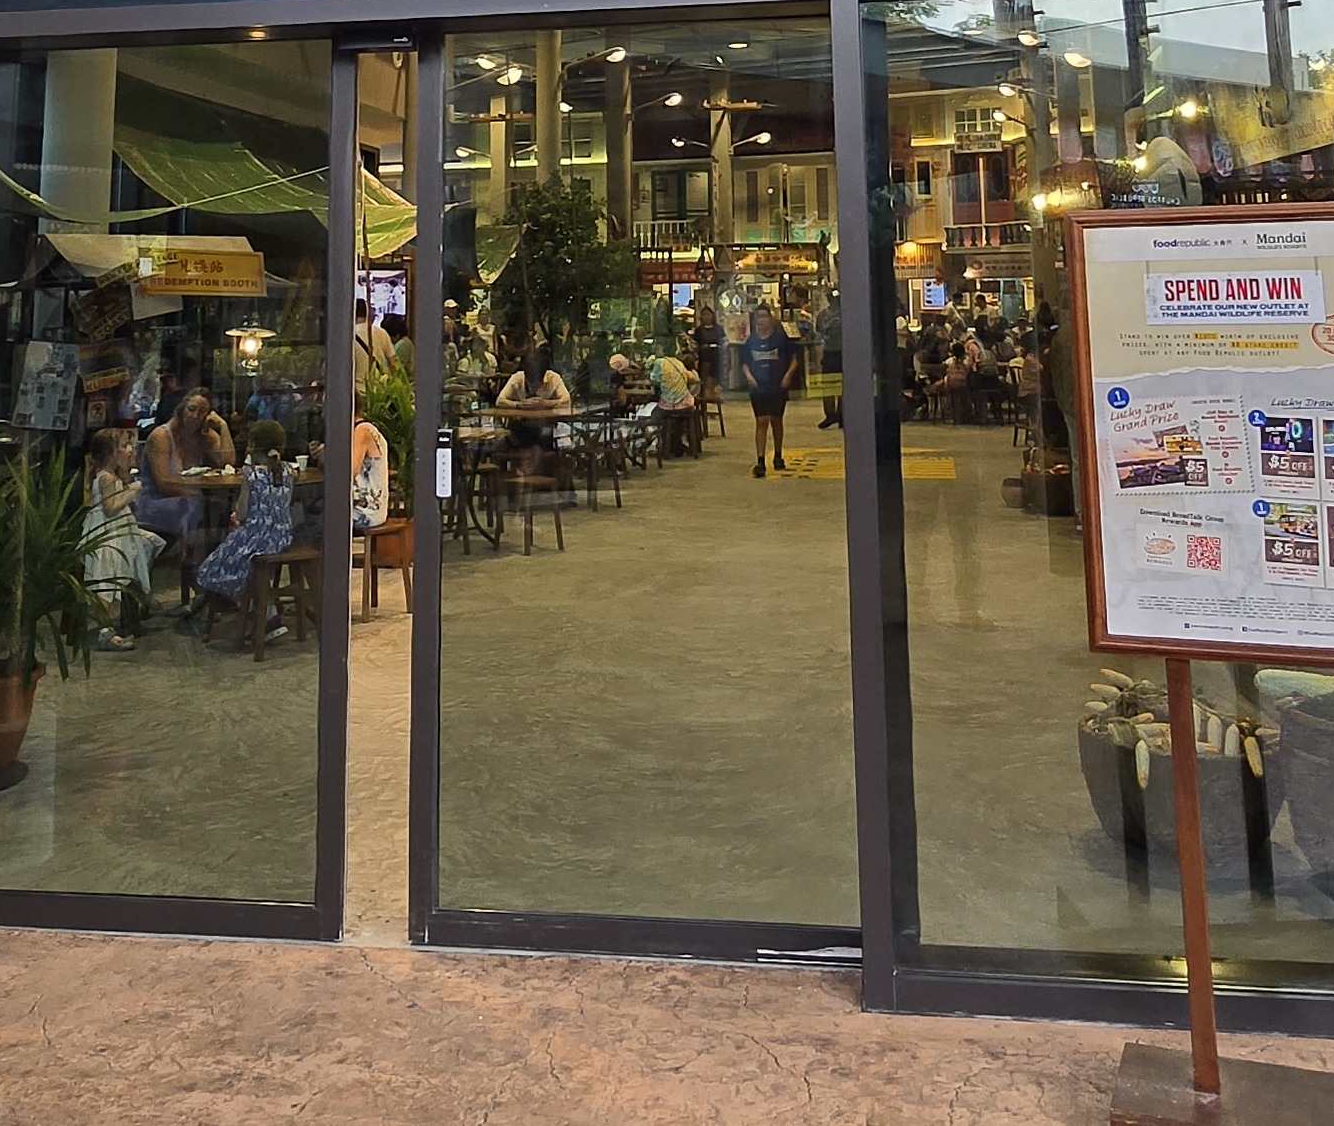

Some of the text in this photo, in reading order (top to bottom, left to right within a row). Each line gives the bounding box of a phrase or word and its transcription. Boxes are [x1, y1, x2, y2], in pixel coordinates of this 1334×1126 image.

[1153, 238, 1211, 248] foodrepublic
[1256, 232, 1307, 244] Mandai
[149, 277, 259, 289] REDEMPTION BOOTH
[1164, 277, 1303, 302] SPEND AND WIN
[1115, 390, 1122, 401] 1
[1270, 398, 1303, 409] Lucky
[1305, 398, 1334, 408] Draw
[1110, 400, 1176, 422] Lucky Draw
[1253, 412, 1261, 422] 2
[1113, 411, 1180, 433] Grand Prize
[1187, 460, 1206, 472] $5
[1267, 454, 1307, 470] $5 OFF
[1259, 502, 1264, 511] 1
[1271, 541, 1312, 558] $5 OFF
